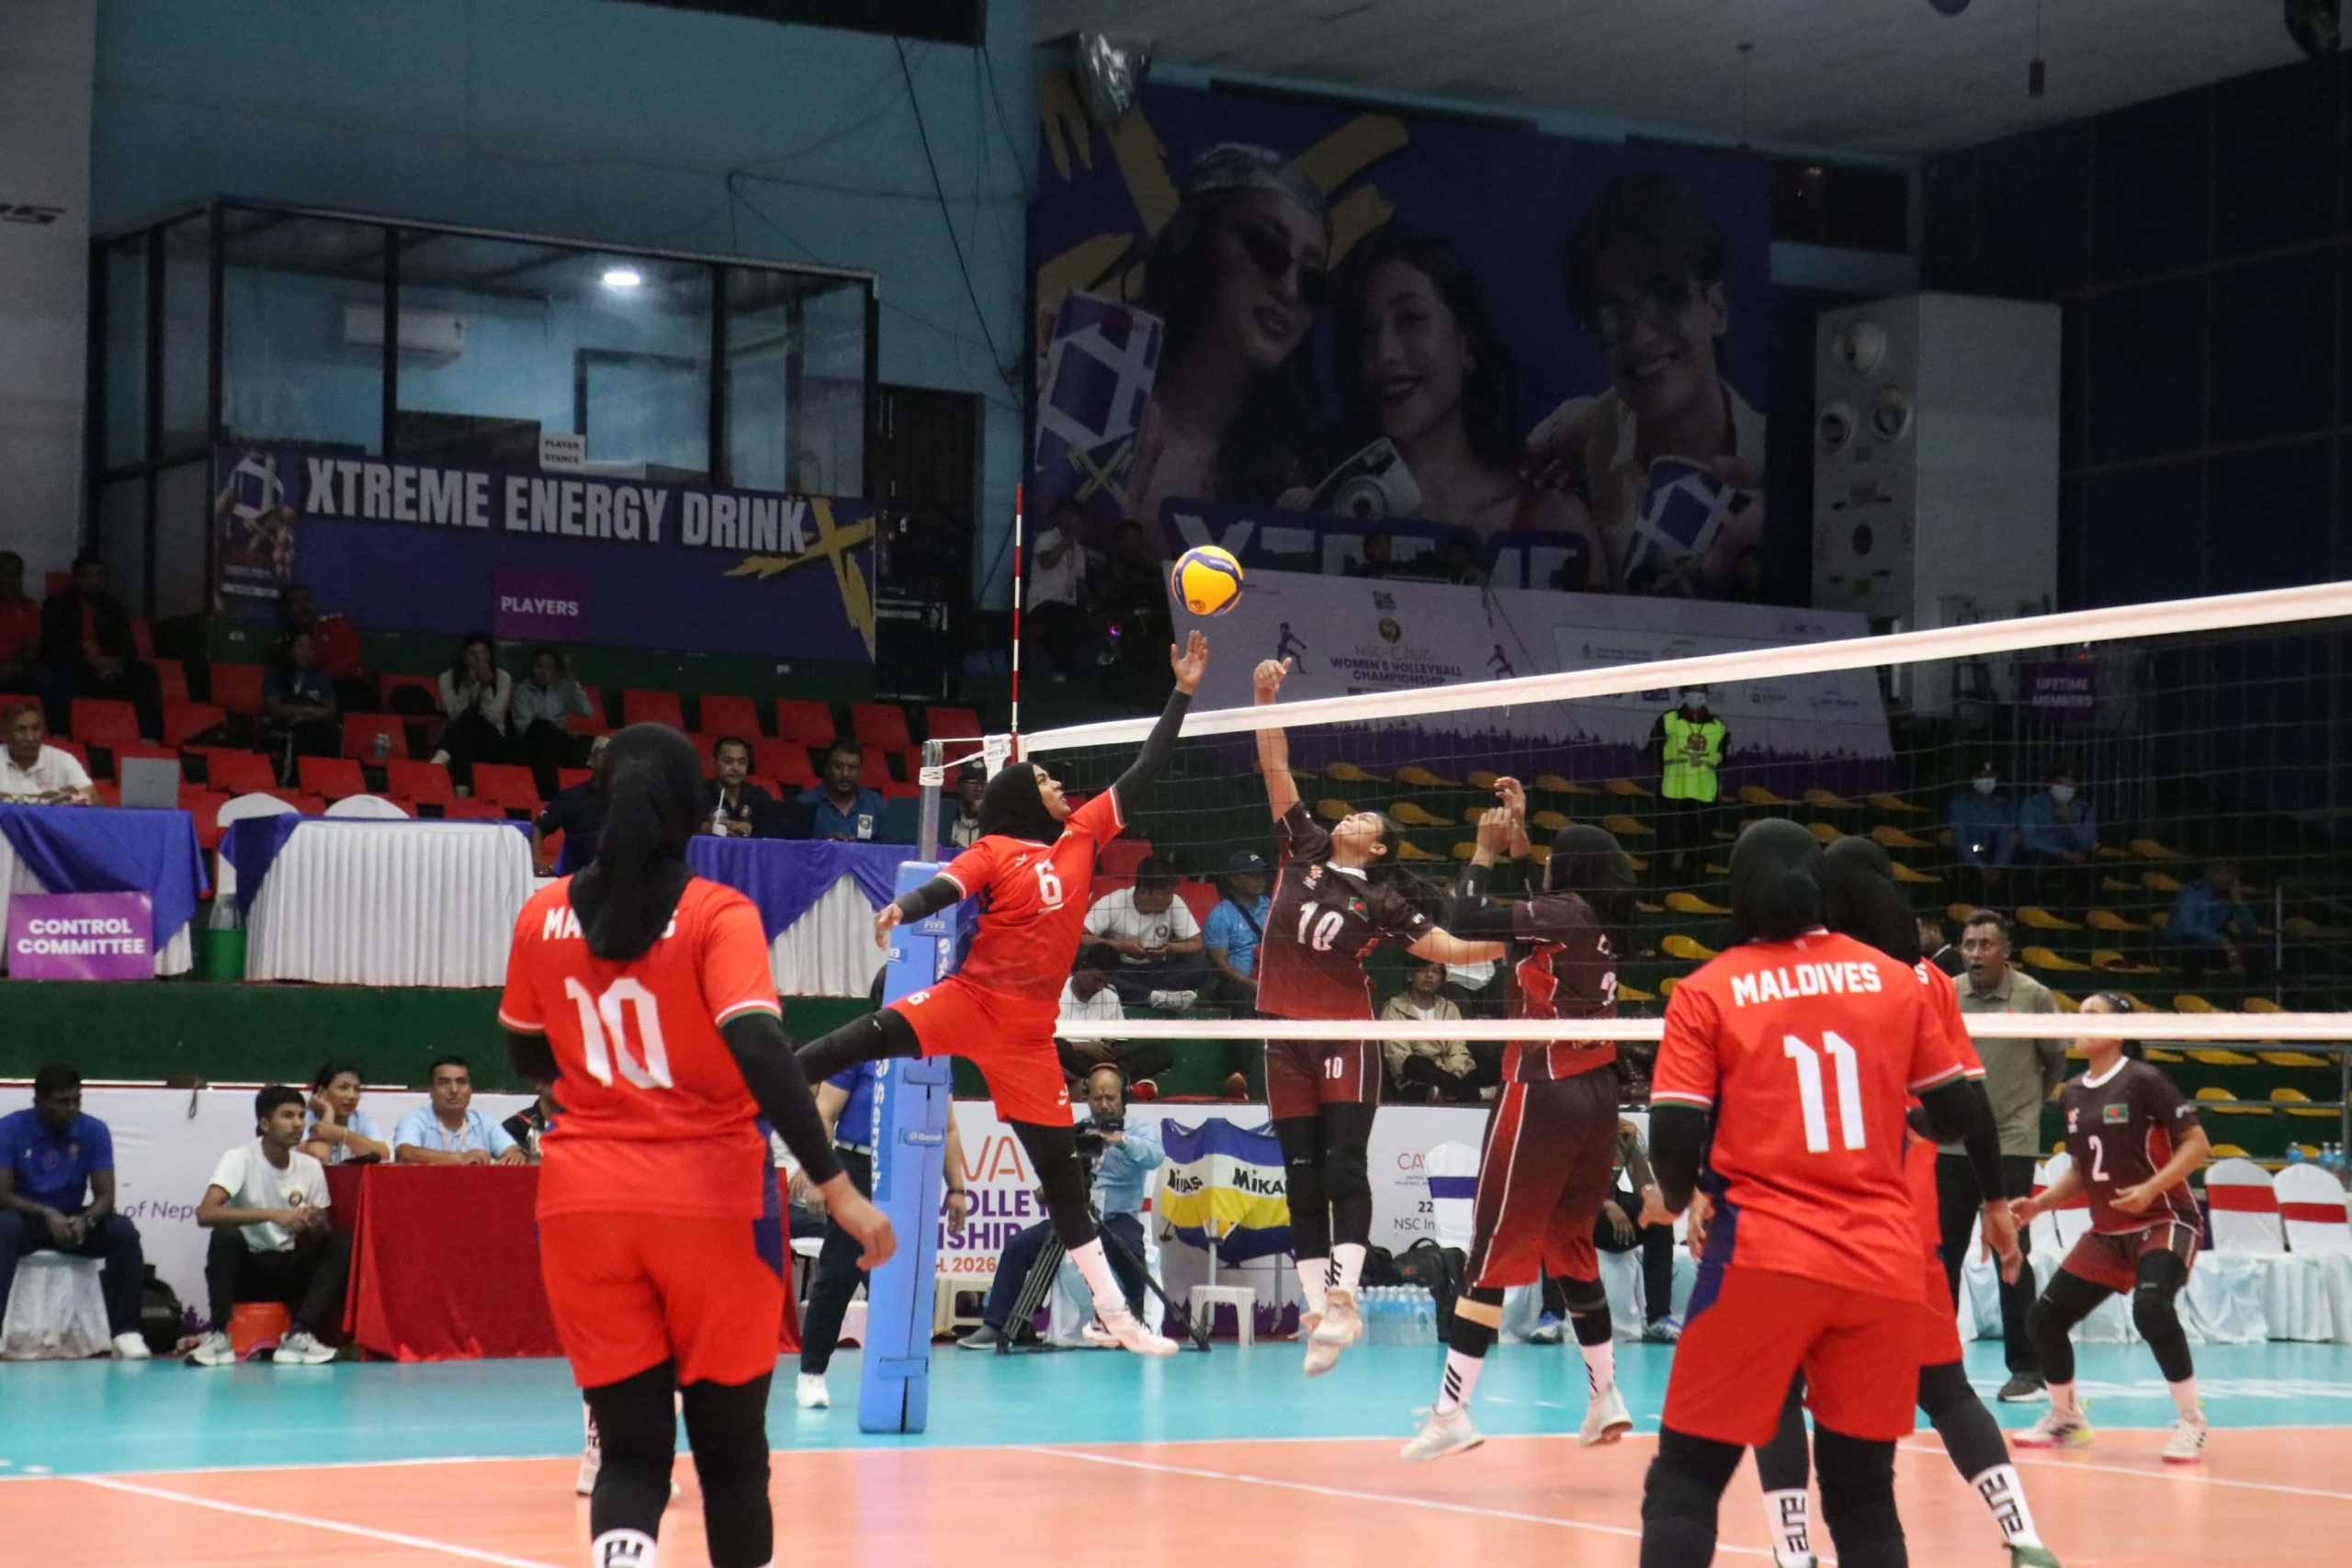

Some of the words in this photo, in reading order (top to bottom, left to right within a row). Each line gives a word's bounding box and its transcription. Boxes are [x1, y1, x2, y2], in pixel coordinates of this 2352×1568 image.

[544, 439, 580, 449] PLAYER
[306, 457, 490, 529] XTREME
[504, 476, 669, 543] ENERGY
[682, 491, 808, 554] DRINK
[501, 596, 580, 617] PLAYERS
[1330, 658, 1390, 671] WOMEN'S
[1391, 661, 1464, 677] VOLLEYBALL
[1352, 671, 1446, 685] CHAMPIONSHIP
[2035, 677, 2088, 691] LIFETIME
[2031, 694, 2094, 707] MEMBERS
[1035, 859, 1063, 906] 6
[28, 918, 133, 935] CONTROL
[1297, 900, 1344, 952] 10
[17, 937, 146, 956] COMMITTEE
[1730, 961, 1883, 1008] MALDIVES
[907, 991, 931, 1006] 6
[564, 976, 673, 1089] 10
[1324, 1056, 1343, 1079] 10
[1783, 1031, 1866, 1155] 11
[1397, 1153, 1425, 1170] CA
[2087, 1135, 2110, 1182] 2
[123, 1200, 147, 1218] of
[1418, 1201, 1433, 1213] 22
[1394, 1218, 1421, 1230] NSC
[1424, 1219, 1435, 1230] In
[953, 1257, 997, 1273] 2026
